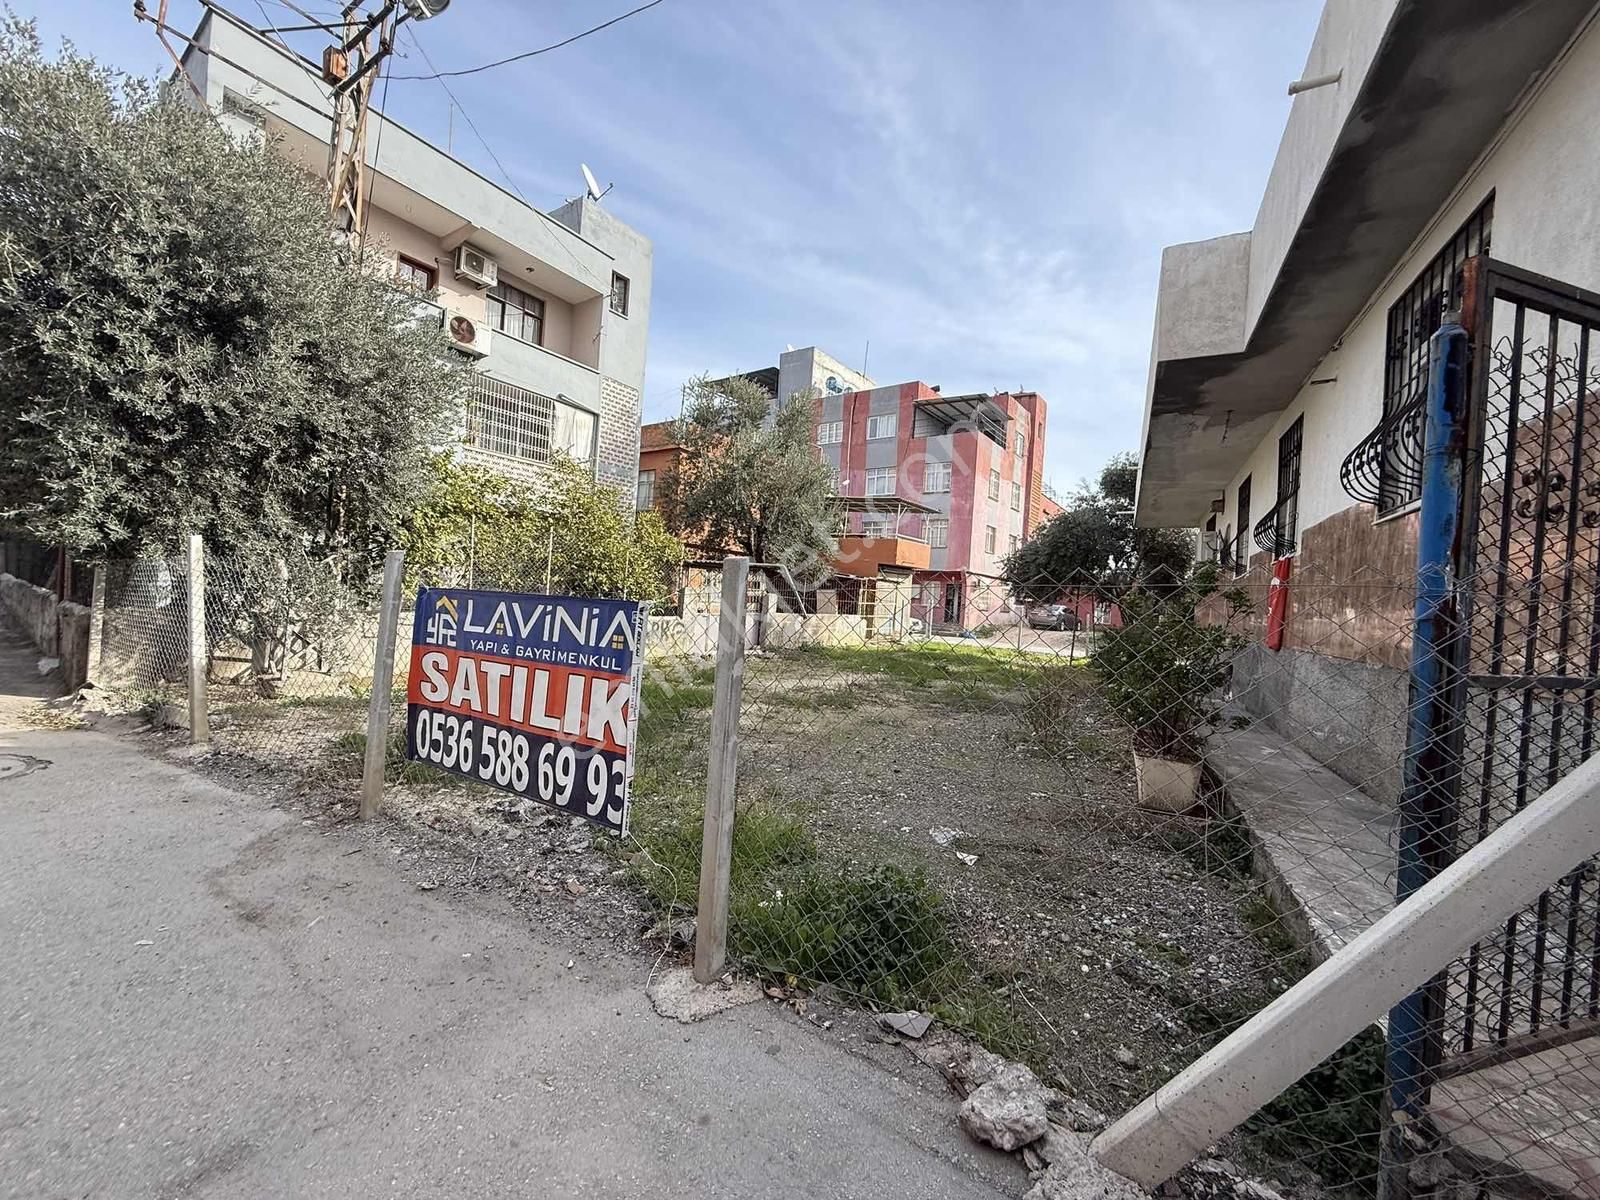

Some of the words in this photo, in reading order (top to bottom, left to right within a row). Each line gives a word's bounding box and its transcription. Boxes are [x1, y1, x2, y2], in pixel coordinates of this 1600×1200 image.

[419, 651, 629, 748] SATILIK
[470, 639, 498, 653] YAPI
[501, 644, 510, 655] &
[515, 645, 622, 671] GAYRİMENKUL
[416, 709, 474, 773] 0536
[478, 725, 530, 792] 588
[538, 742, 576, 806] 69
[586, 754, 626, 825] 93
